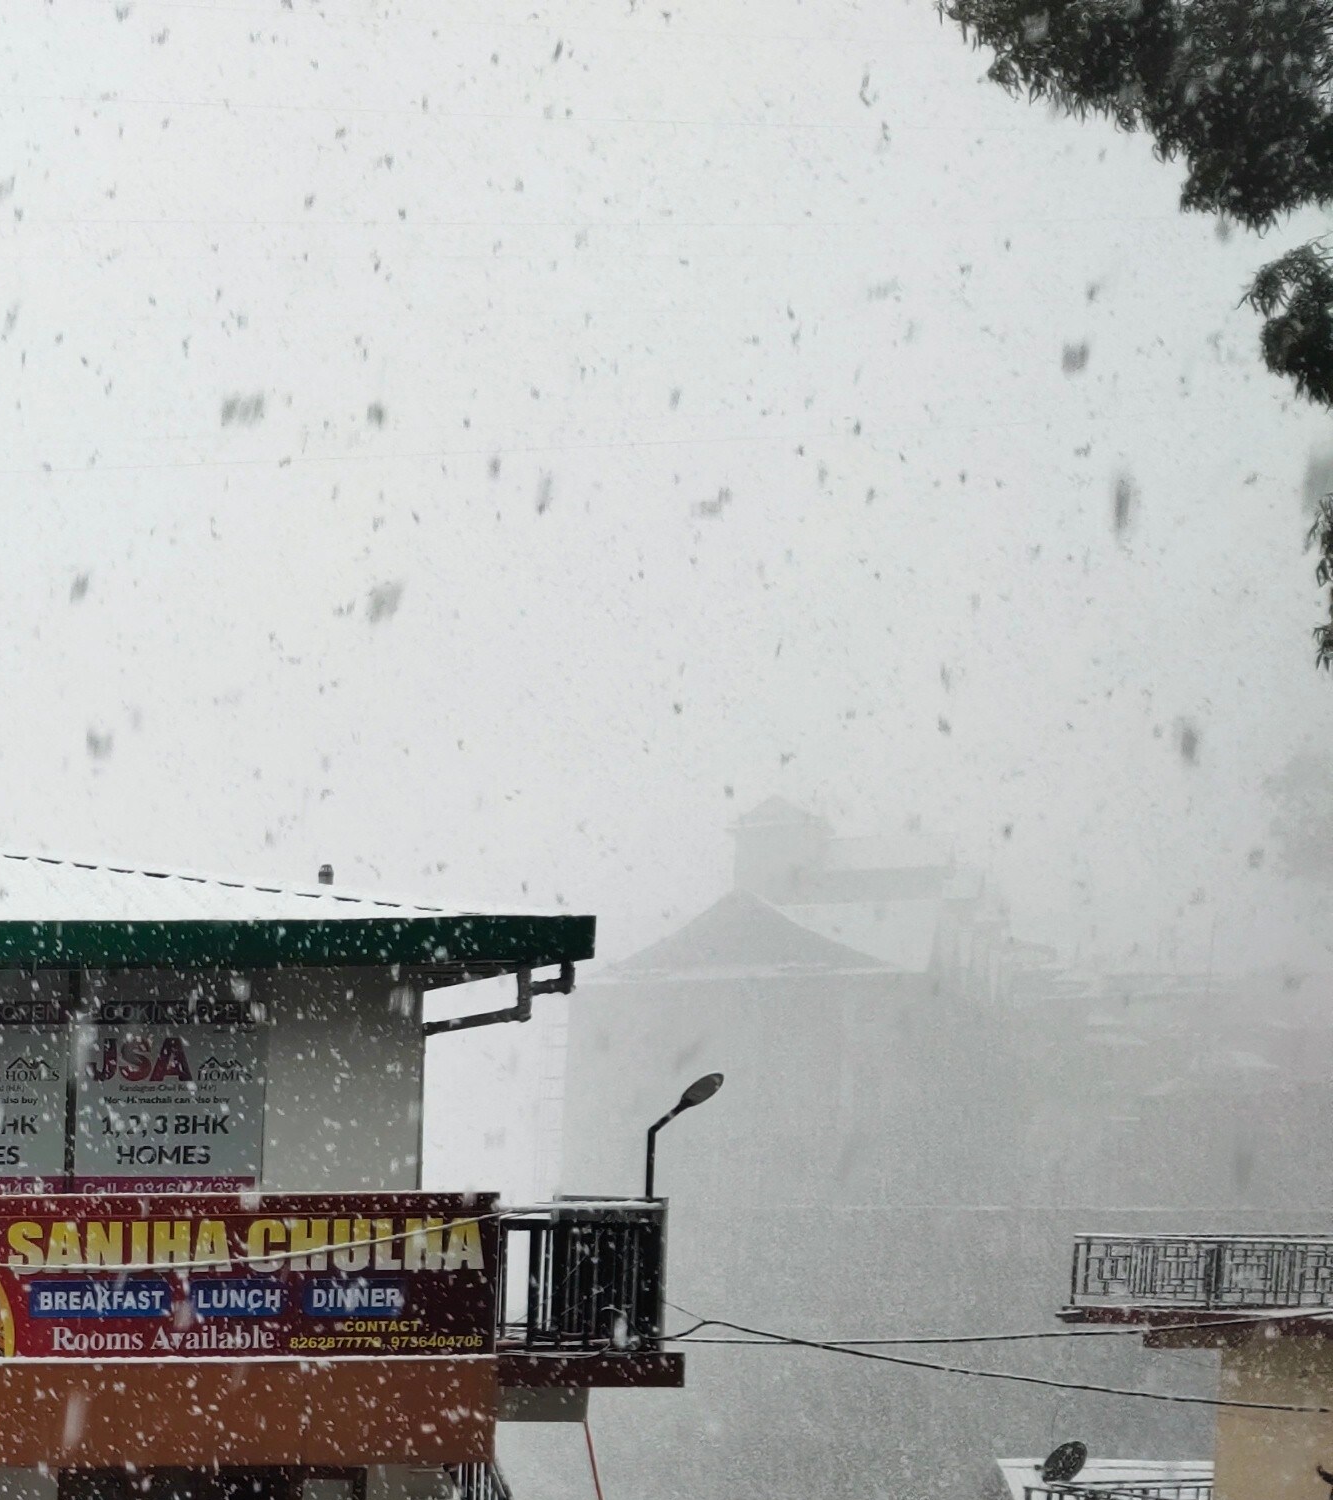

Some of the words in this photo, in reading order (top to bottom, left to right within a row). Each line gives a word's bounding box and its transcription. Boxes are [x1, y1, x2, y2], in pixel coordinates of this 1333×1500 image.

[2, 1003, 61, 1021] OPEN
[86, 1037, 193, 1082] JSA
[21, 1096, 39, 1106] buy
[101, 1116, 120, 1138] 1,
[153, 1115, 169, 1135] 3
[174, 1115, 230, 1135] BHK
[116, 1145, 212, 1165] HOMES
[7, 1220, 232, 1275] SANJHA
[247, 1217, 485, 1273] CHULHA
[39, 1290, 165, 1311] BREAKFAST
[197, 1288, 281, 1309] LUNCH
[312, 1288, 402, 1308] DINNER
[343, 1320, 421, 1333] CONTACT
[51, 1326, 144, 1351] Rooms
[150, 1324, 275, 1350] Available
